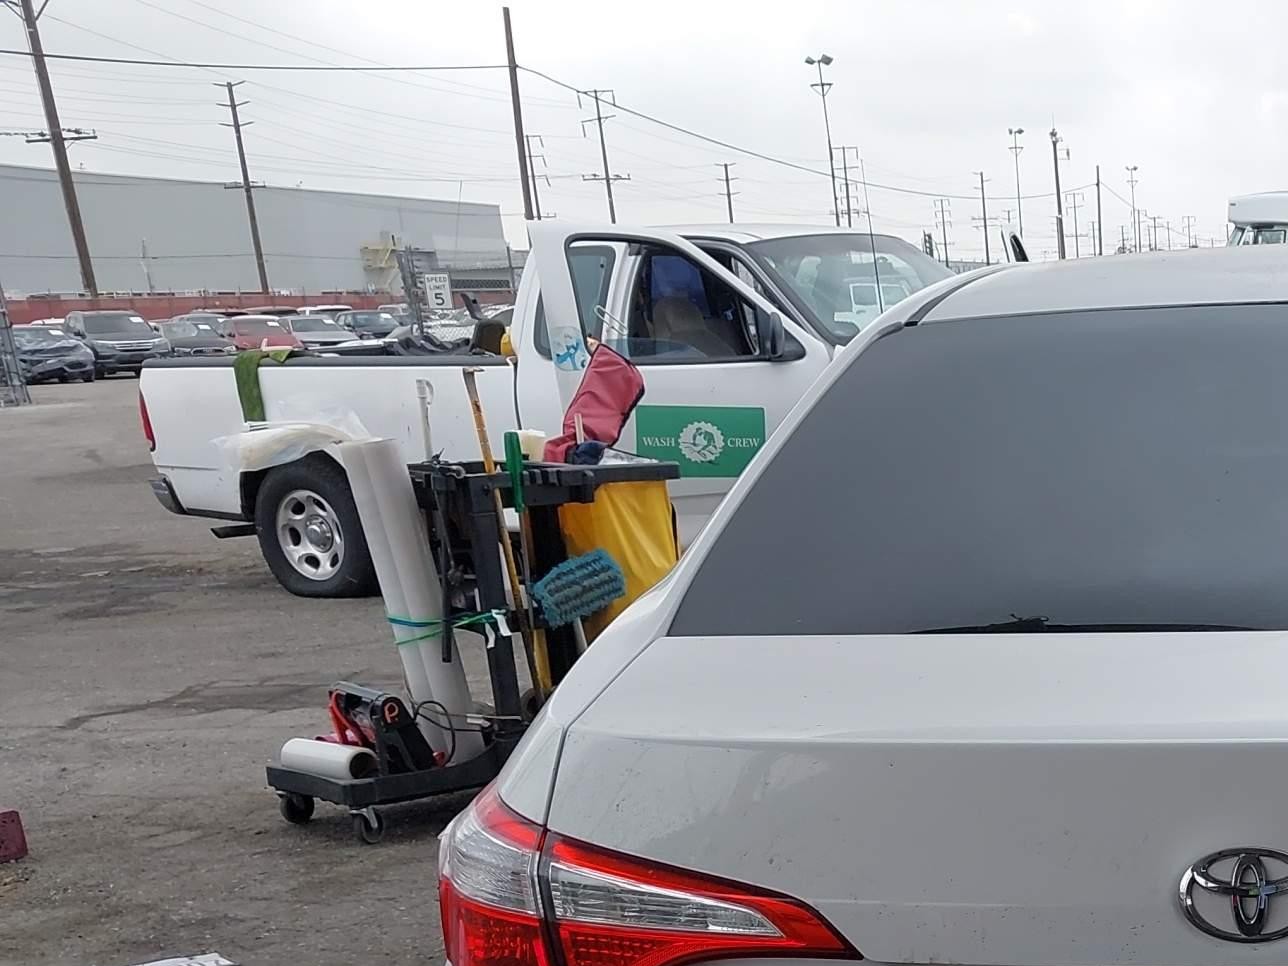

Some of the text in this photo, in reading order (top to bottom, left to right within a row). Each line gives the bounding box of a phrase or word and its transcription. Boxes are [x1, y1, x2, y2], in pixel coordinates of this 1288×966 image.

[434, 292, 446, 306] 5
[642, 436, 761, 448] WASH CREW
